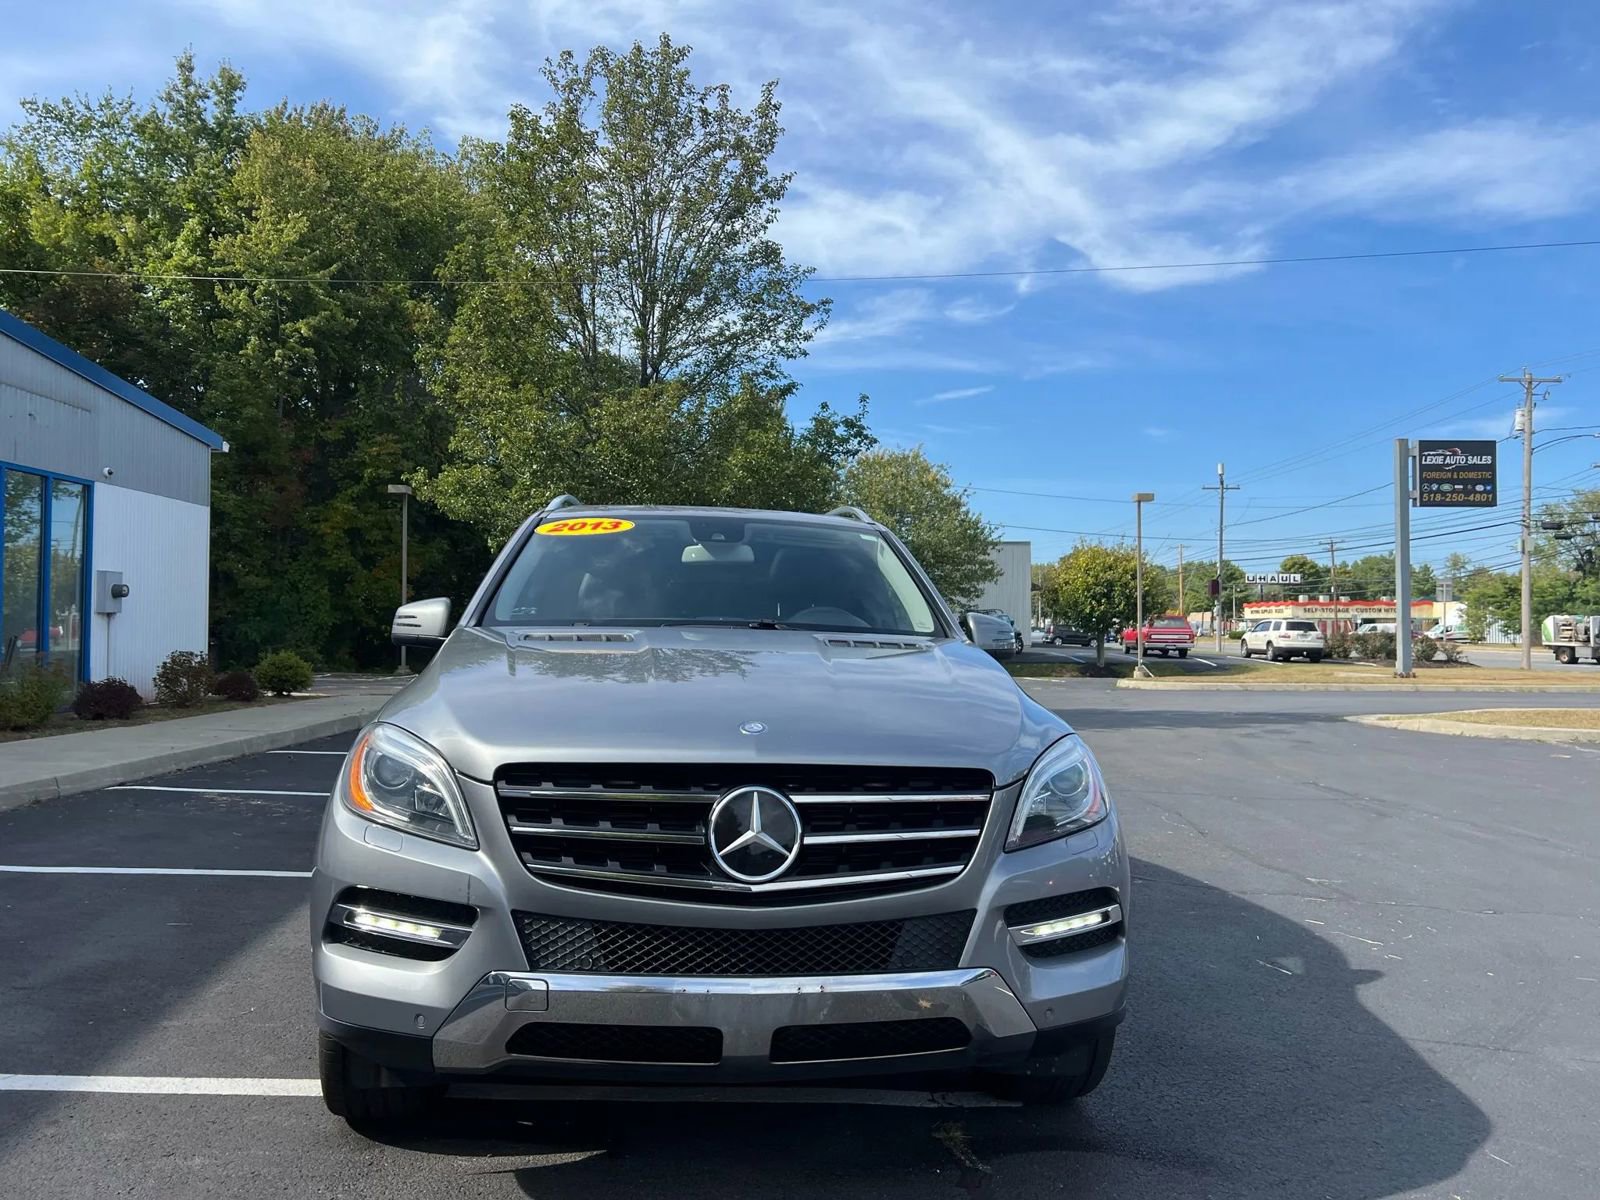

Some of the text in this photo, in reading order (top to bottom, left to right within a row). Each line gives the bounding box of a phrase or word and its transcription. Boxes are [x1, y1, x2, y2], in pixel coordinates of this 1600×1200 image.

[1422, 456, 1492, 464] LEXIE AUTO SALES
[1423, 493, 1493, 501] 518-250-4801
[547, 521, 622, 533] 2013
